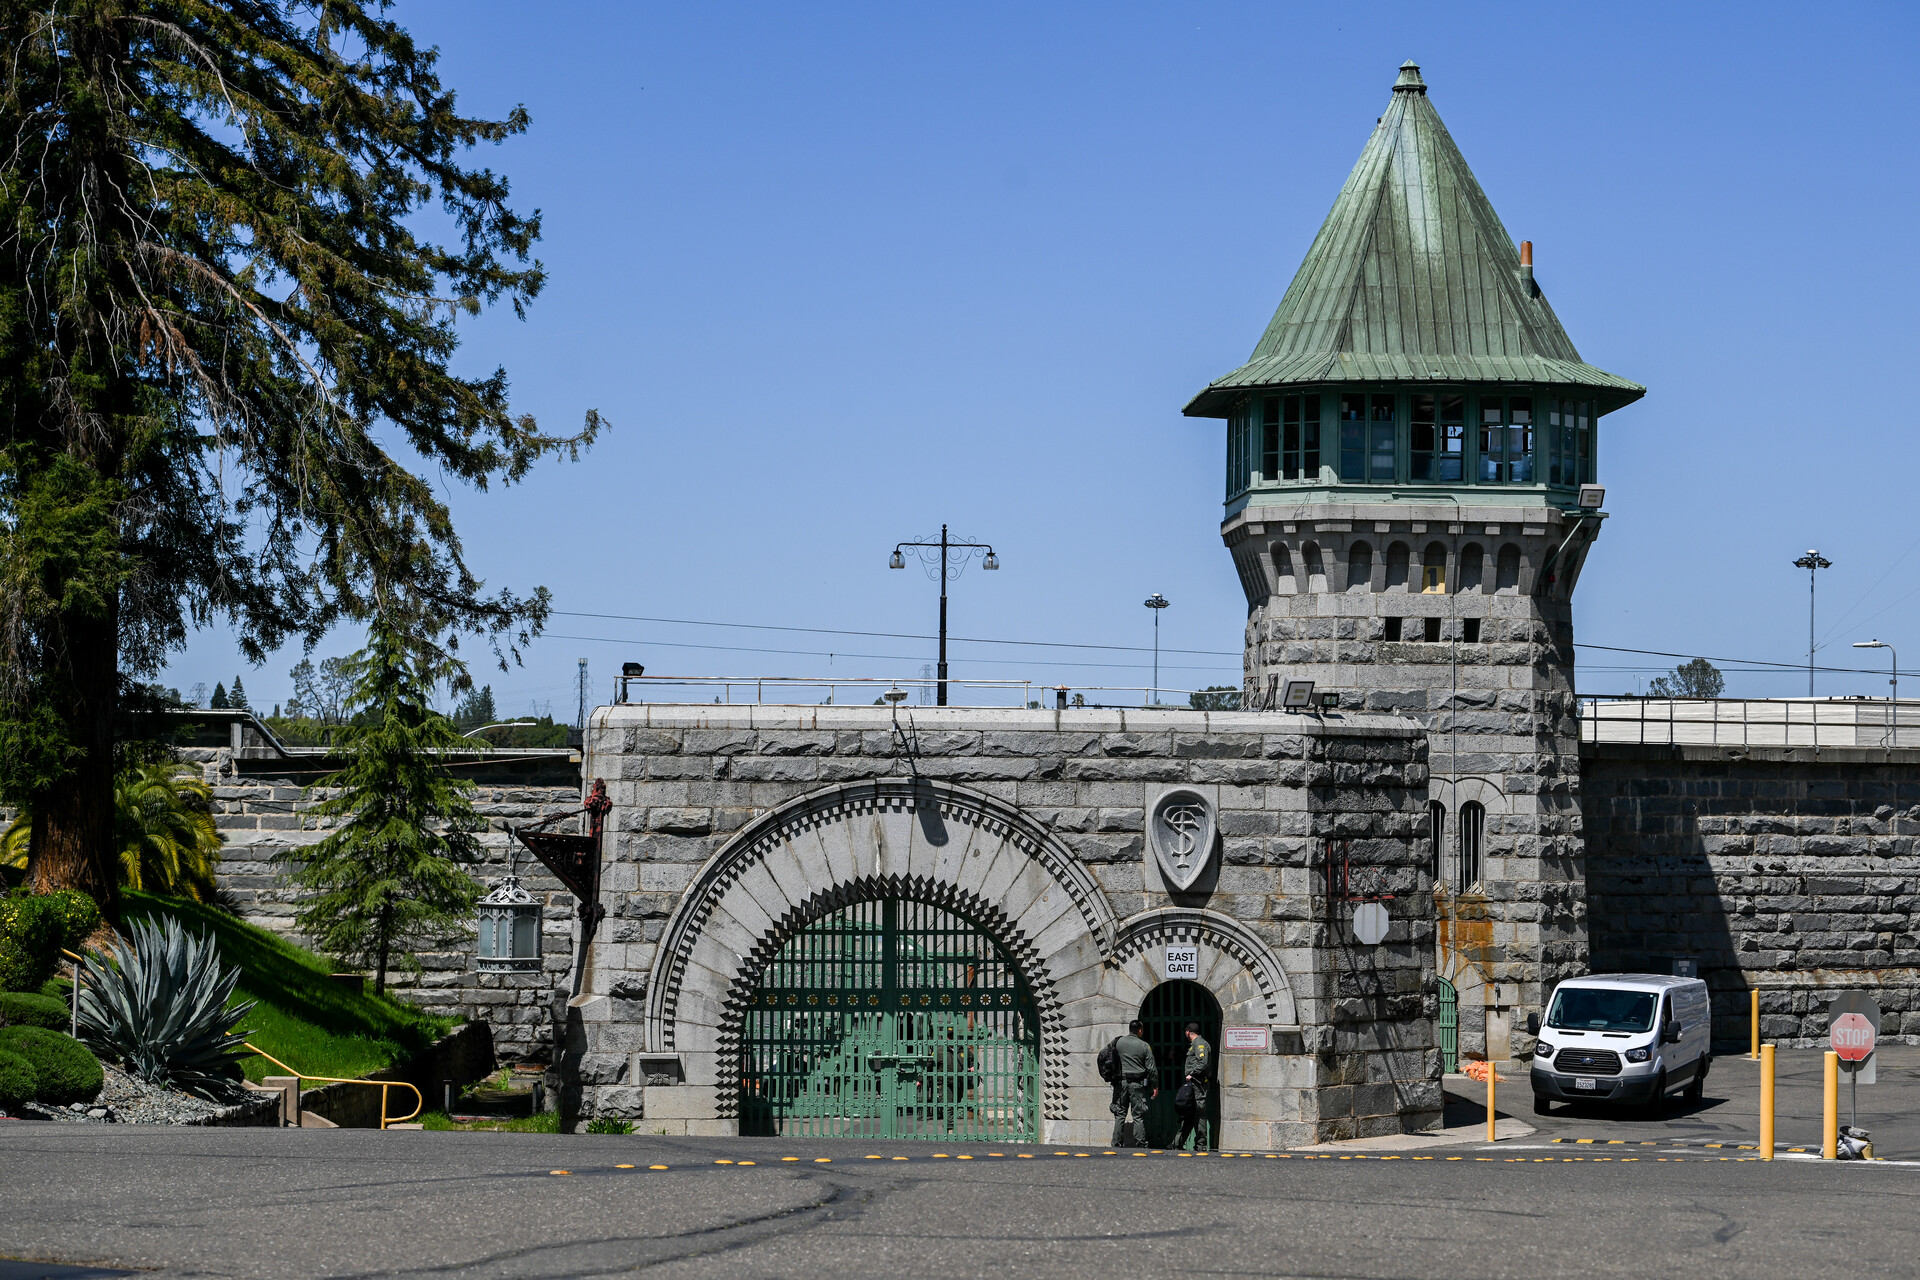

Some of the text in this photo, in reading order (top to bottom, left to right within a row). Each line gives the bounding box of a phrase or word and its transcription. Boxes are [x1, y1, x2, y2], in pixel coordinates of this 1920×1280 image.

[1427, 567, 1437, 592] 1
[1167, 952, 1195, 962] EAST
[1167, 963, 1195, 973] GATE
[1835, 1027, 1870, 1046] STOP
